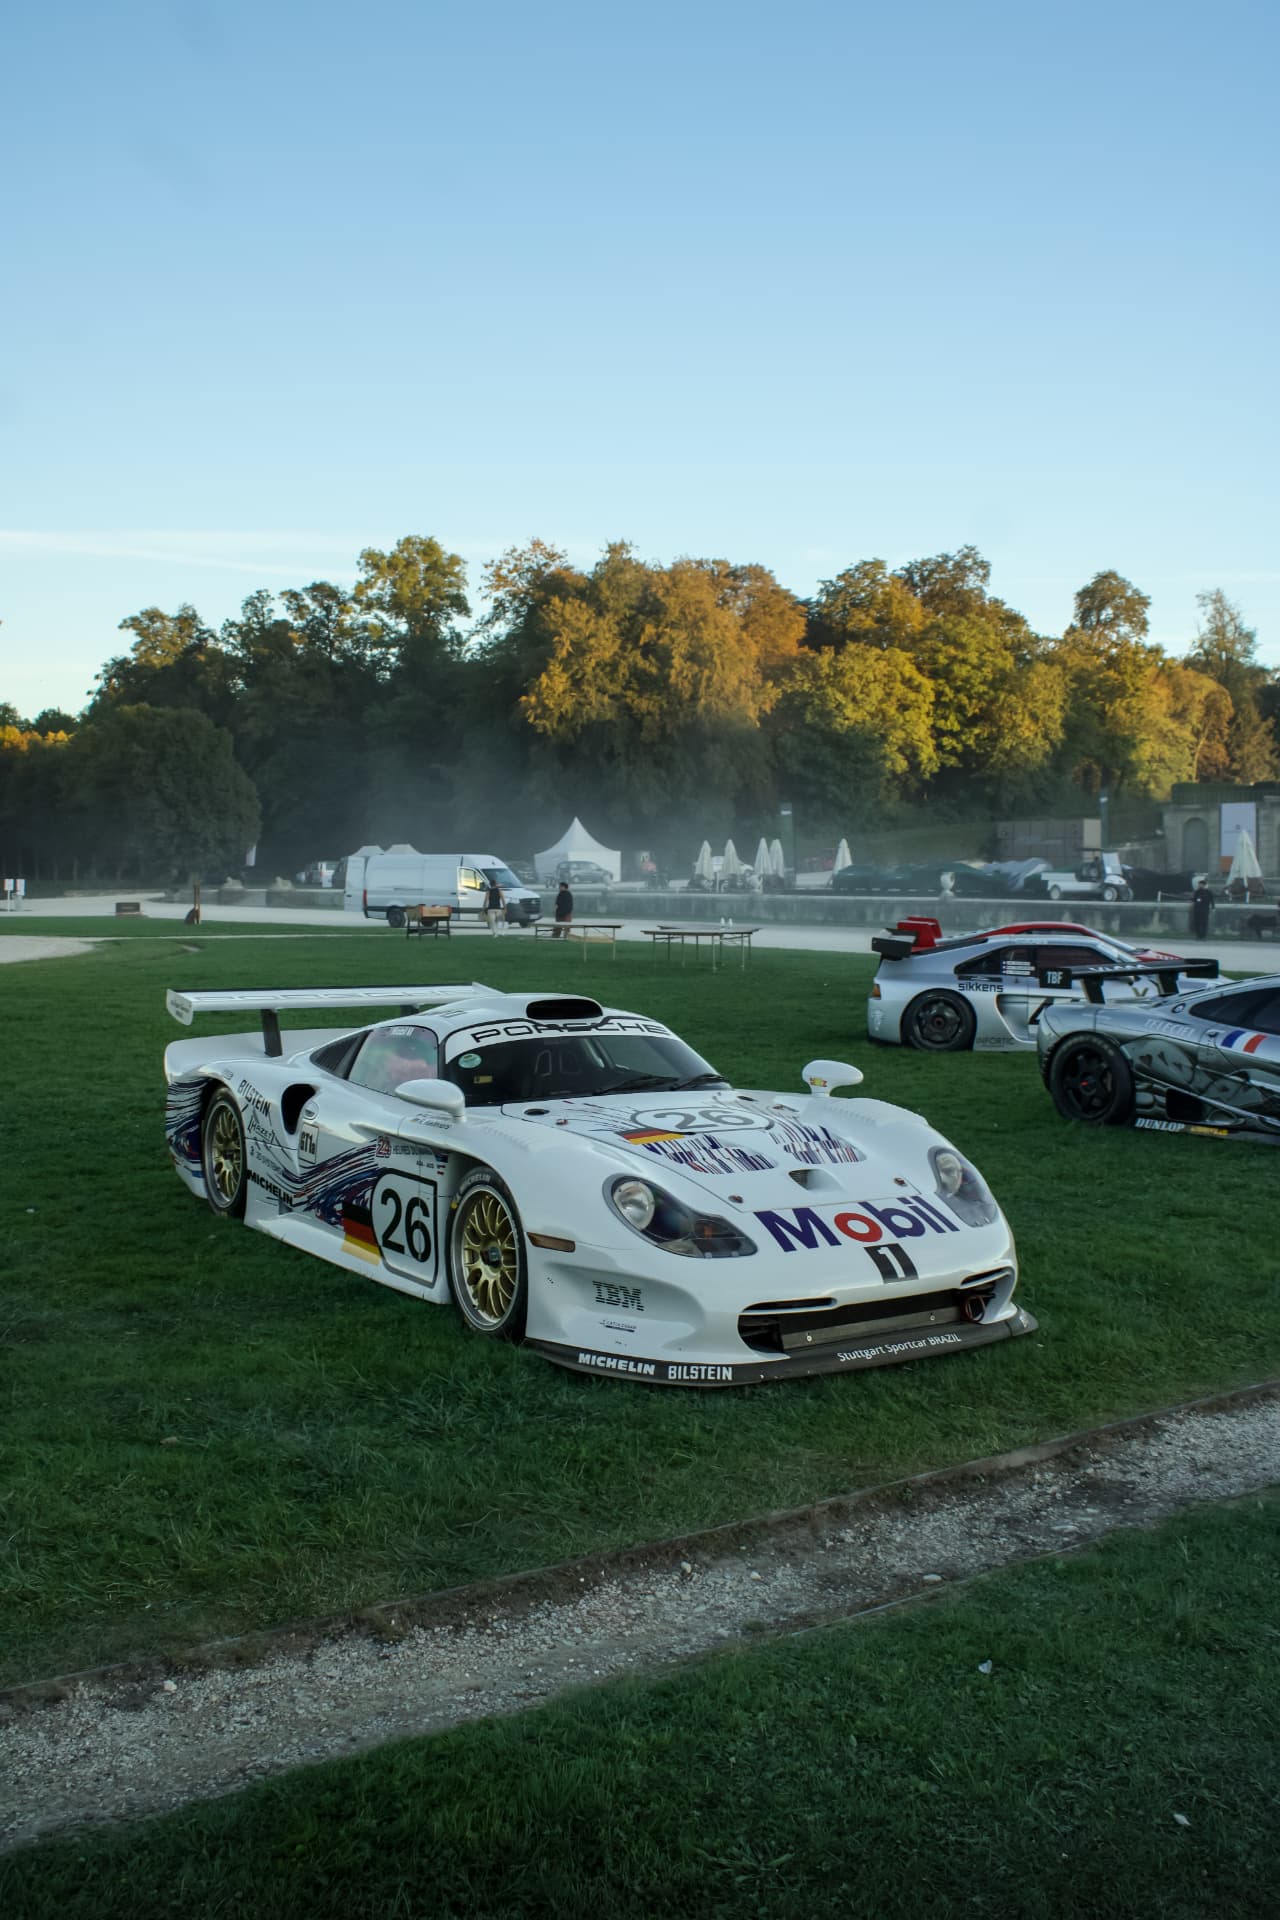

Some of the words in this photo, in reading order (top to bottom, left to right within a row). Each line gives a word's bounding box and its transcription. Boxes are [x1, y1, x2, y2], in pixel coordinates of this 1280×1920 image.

[958, 982, 1004, 993] sikkens
[1047, 970, 1063, 984] TBF
[471, 1022, 668, 1043] PORSCHE
[237, 1079, 272, 1118] BILSTEIN
[654, 1109, 754, 1130] 26
[1134, 1118, 1185, 1132] DUNLOP
[376, 1135, 392, 1158] 24
[247, 1170, 293, 1206] MICHELIN
[381, 1188, 432, 1263] 26
[753, 1195, 961, 1253] Mobil
[877, 1245, 906, 1280] 1
[592, 1280, 645, 1312] IBM
[837, 1343, 885, 1362] Stuttgart
[885, 1337, 927, 1354] Sportcar
[929, 1333, 962, 1346] BRAZIL
[578, 1352, 656, 1375] MICHELIN
[668, 1365, 733, 1381] BILSTEIN
